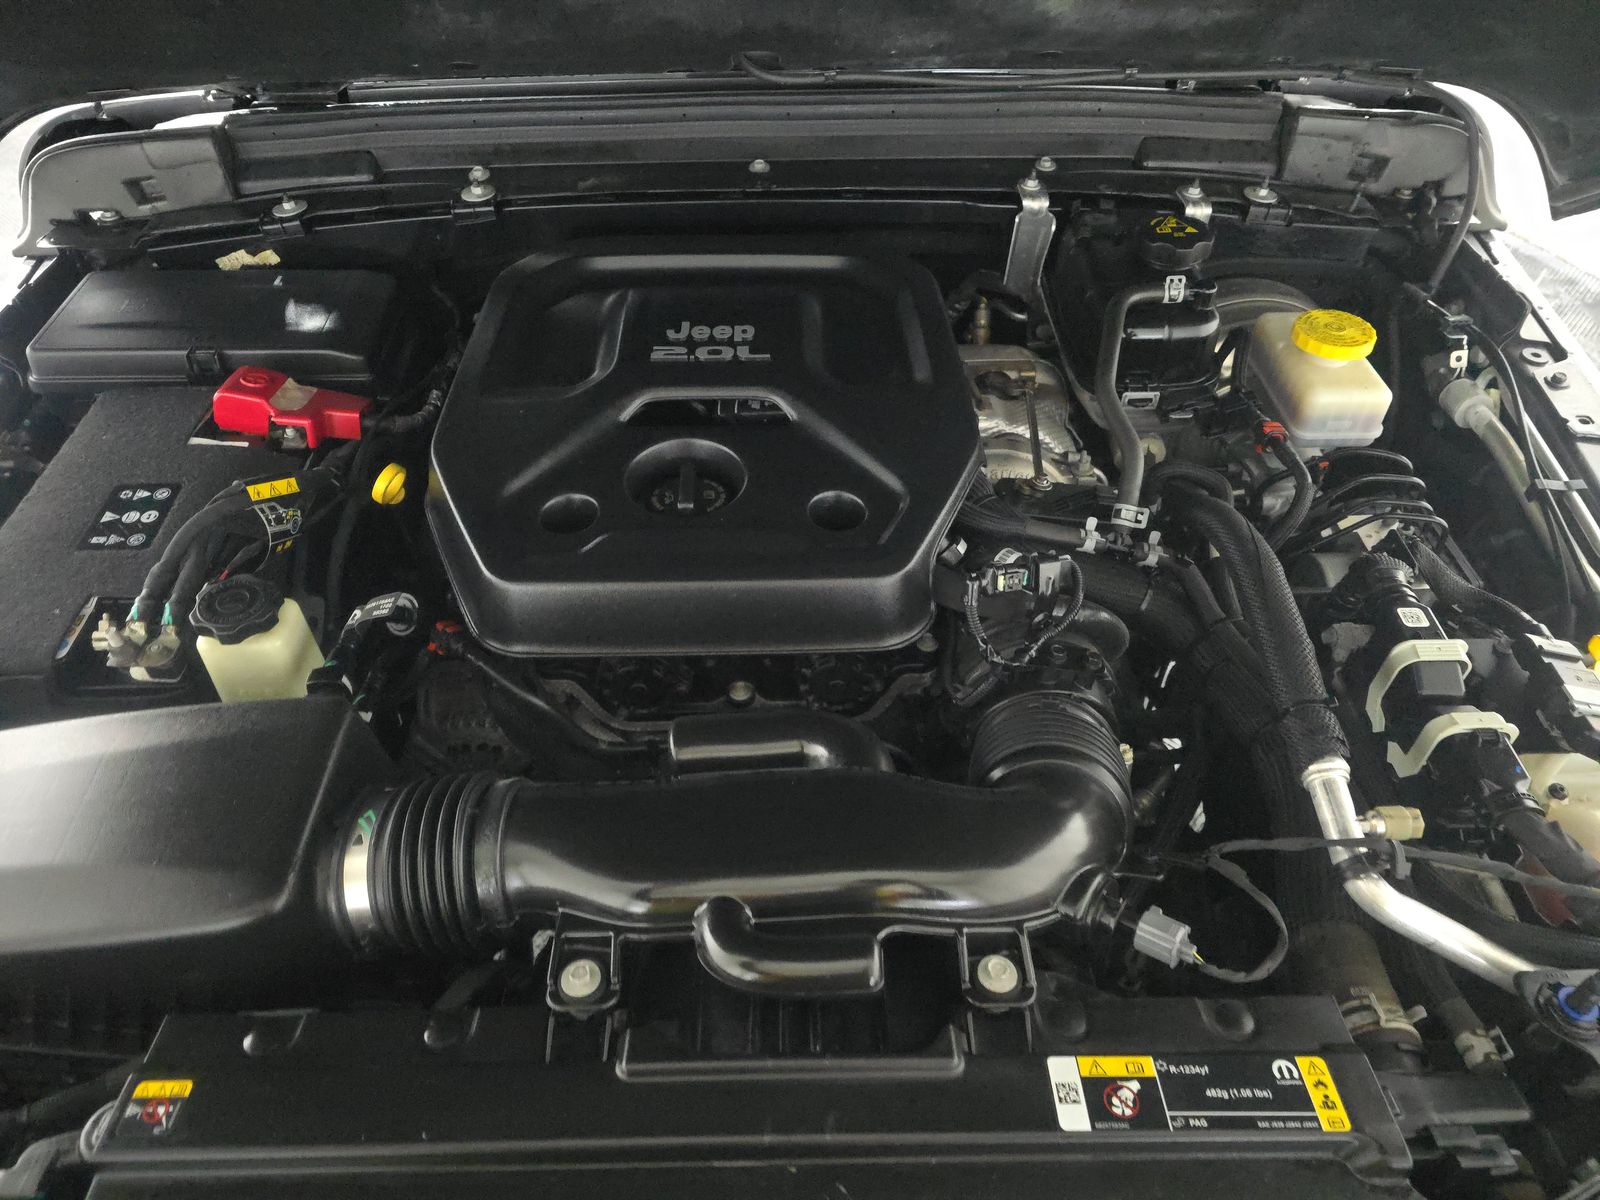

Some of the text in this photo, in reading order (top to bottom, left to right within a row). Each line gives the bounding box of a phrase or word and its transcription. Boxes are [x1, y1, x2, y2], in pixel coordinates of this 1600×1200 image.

[666, 321, 755, 342] Jeep
[650, 345, 771, 361] 2.0L
[1168, 1064, 1209, 1076] R-1234yf
